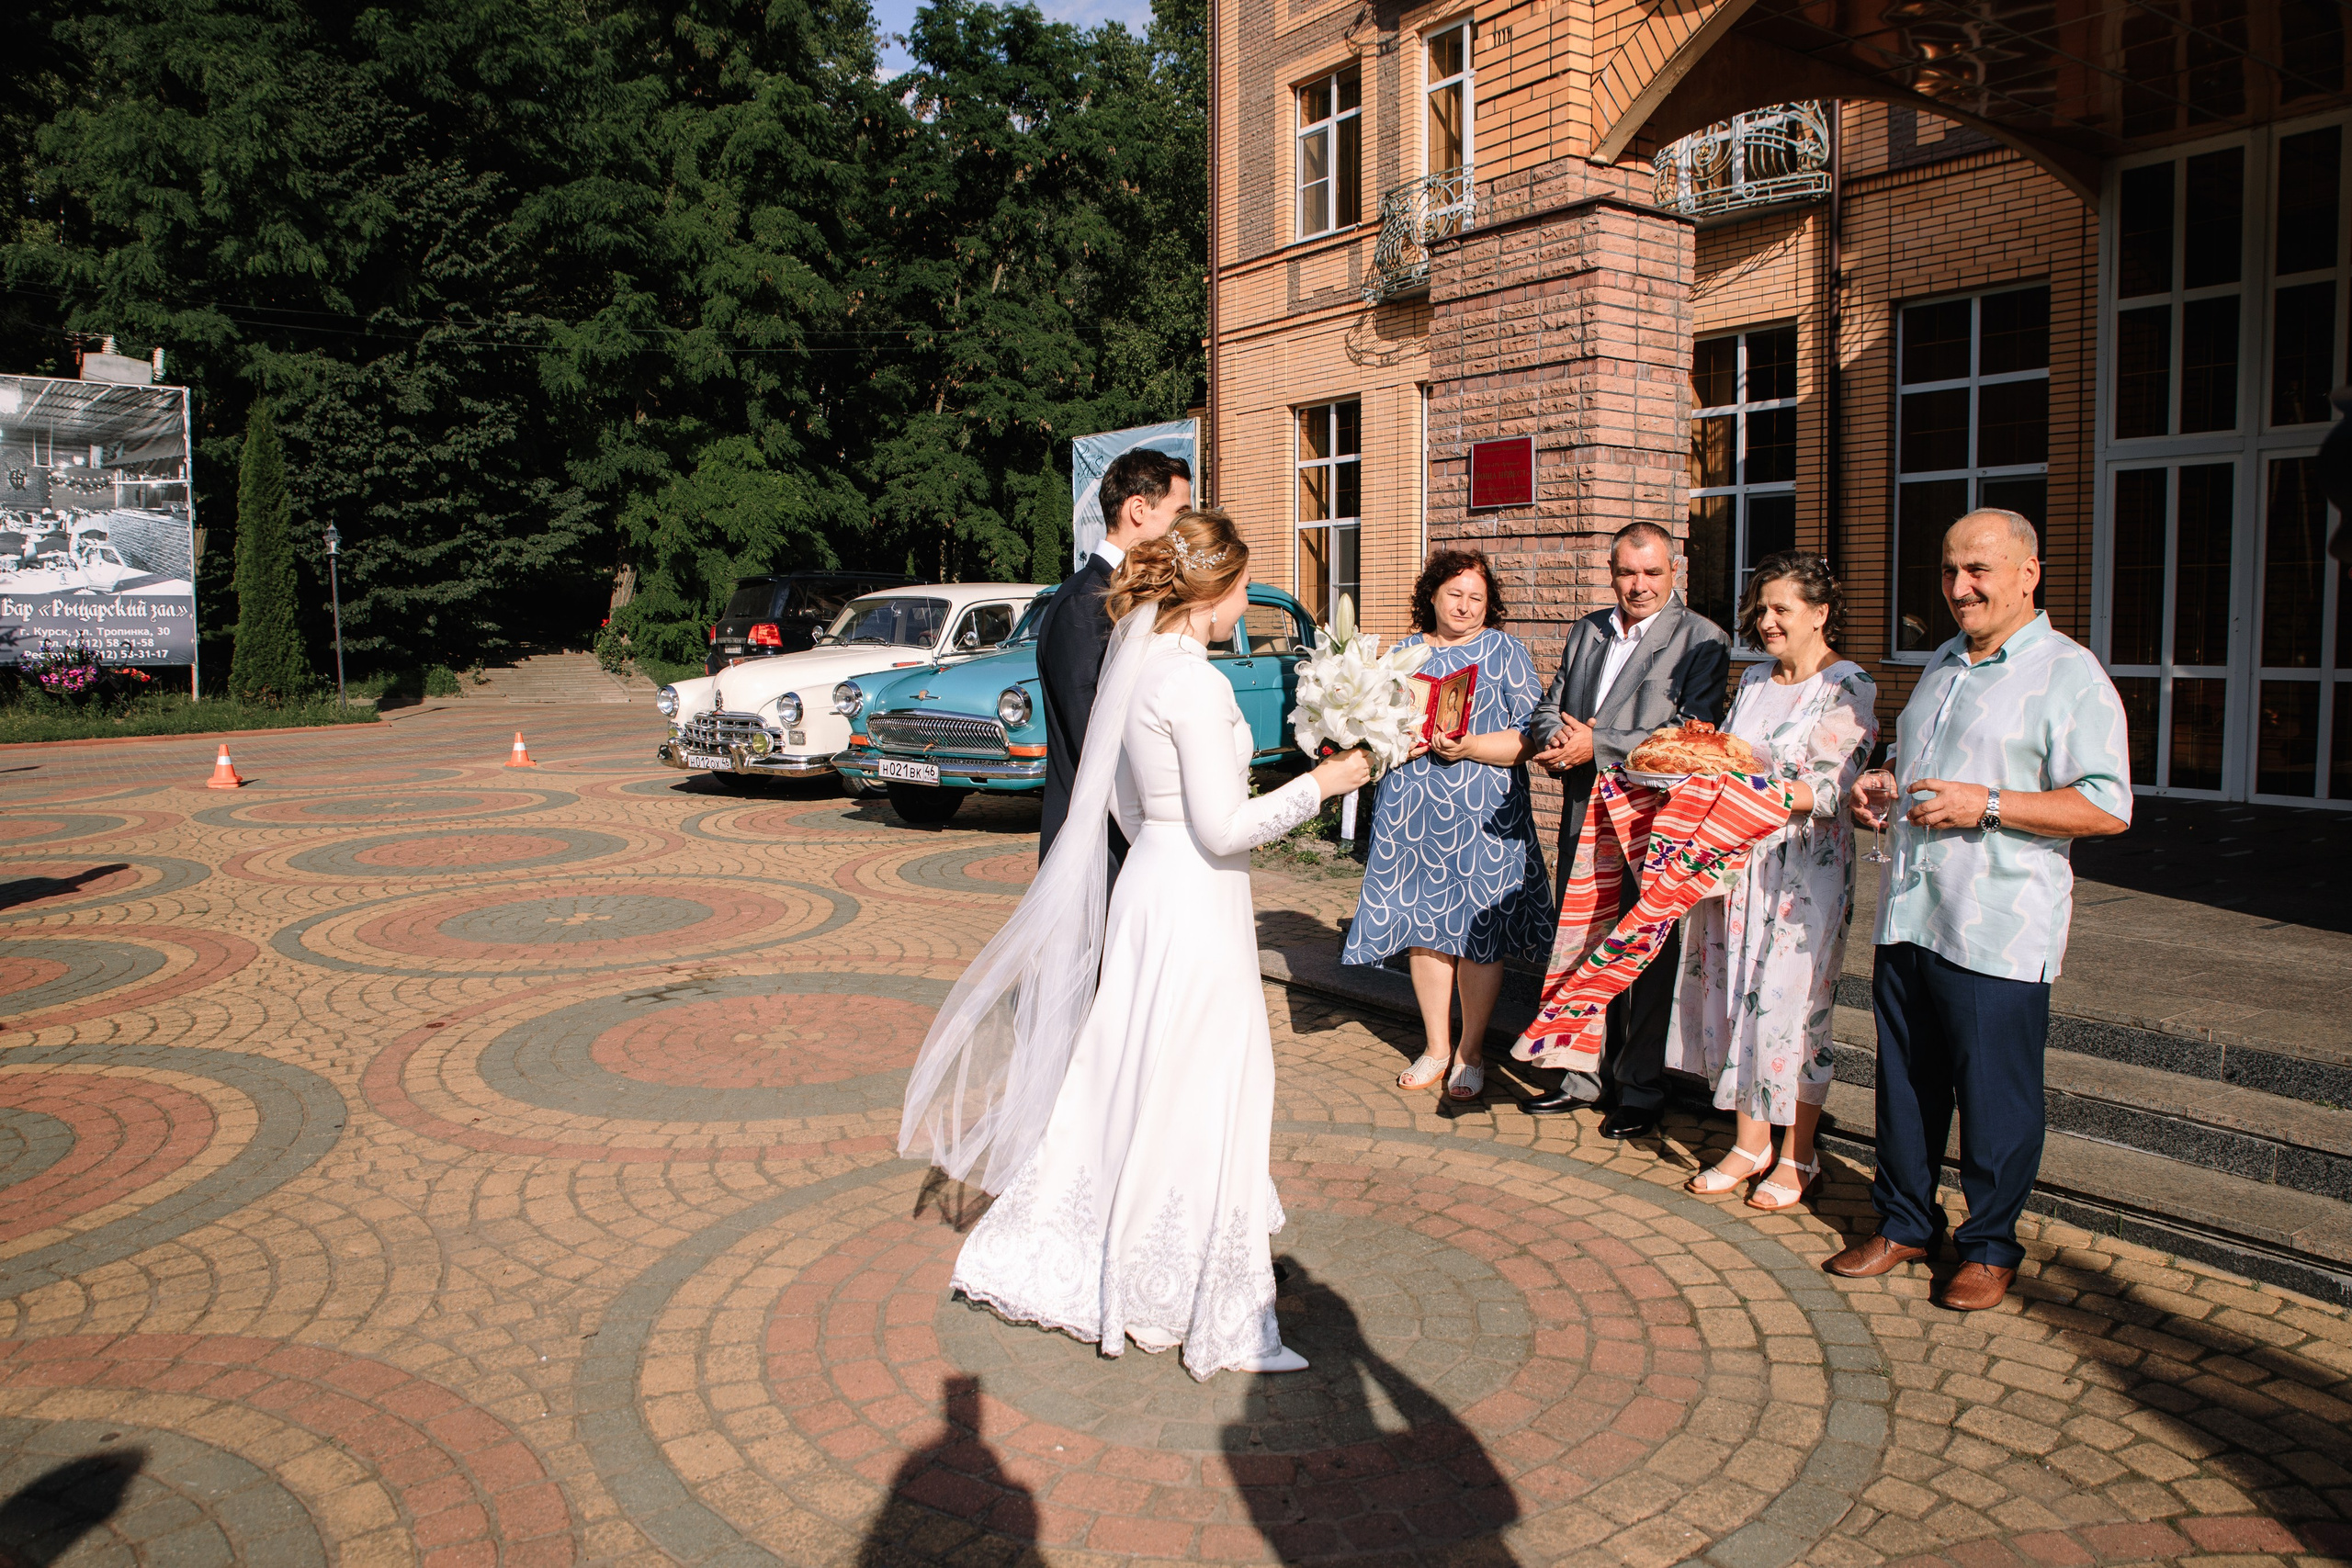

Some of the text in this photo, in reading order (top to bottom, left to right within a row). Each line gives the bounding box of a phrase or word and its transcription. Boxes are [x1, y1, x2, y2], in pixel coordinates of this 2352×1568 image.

[1, 592, 188, 622] Бар «Рыцарский зал»
[33, 626, 72, 637] Курск,
[96, 626, 153, 637] Тропинка,
[157, 626, 171, 636] 30
